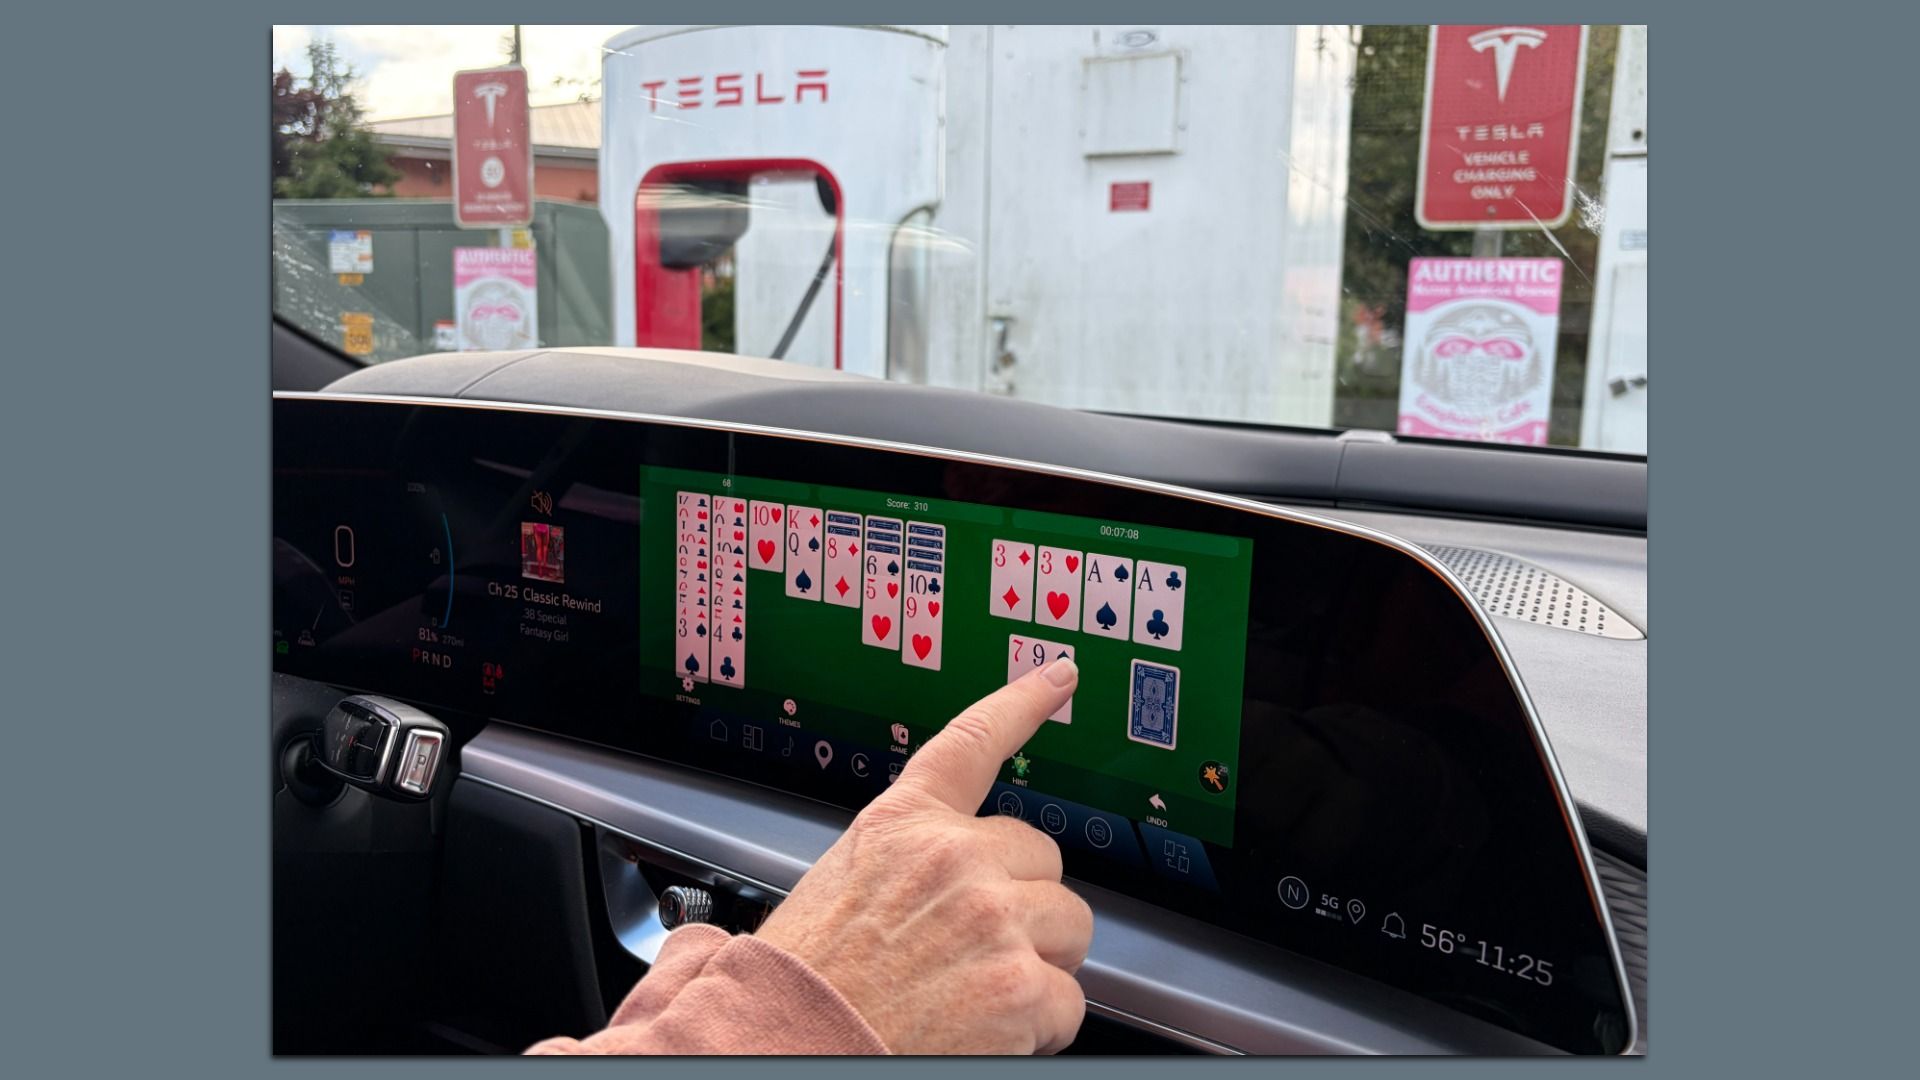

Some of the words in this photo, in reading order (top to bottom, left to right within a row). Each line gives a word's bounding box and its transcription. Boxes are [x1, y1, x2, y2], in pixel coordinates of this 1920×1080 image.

[641, 69, 829, 113] TESLA
[1455, 122, 1545, 141] TESLA
[1463, 150, 1531, 166] VEHICLE
[1453, 166, 1537, 184] CHARGING
[1470, 184, 1516, 200] ONLY
[1415, 261, 1558, 283] AUTHENTIC
[886, 498, 910, 510] Score:
[914, 501, 929, 512] 310
[753, 506, 770, 527] 10
[788, 509, 800, 529] K
[1099, 525, 1140, 541] 00:07:08
[335, 525, 355, 568] 0
[788, 533, 800, 557] Q
[827, 537, 838, 558] 8
[866, 555, 878, 576] 6
[994, 544, 1007, 568] 3
[1040, 551, 1053, 575] 3
[1087, 559, 1103, 584] A
[1137, 567, 1154, 592] A
[866, 578, 876, 600] 5
[909, 574, 927, 596] 10
[487, 581, 503, 596] Ch
[505, 584, 519, 599] 25
[522, 587, 561, 606] Classic
[561, 593, 602, 614] Rewind
[906, 597, 918, 618] 9
[536, 609, 568, 626] Special
[678, 618, 688, 638] 3
[519, 622, 552, 642] Fantasy
[553, 628, 569, 643] Girl
[713, 623, 723, 642] 4
[1012, 638, 1024, 662] 7
[1032, 643, 1046, 667] 9
[890, 744, 908, 756] GAME
[1012, 776, 1029, 788] HINT
[1145, 814, 1168, 828] UNDO
[1321, 893, 1340, 910] 5G
[1420, 922, 1466, 955] 56°
[1476, 939, 1554, 987] 11:25
